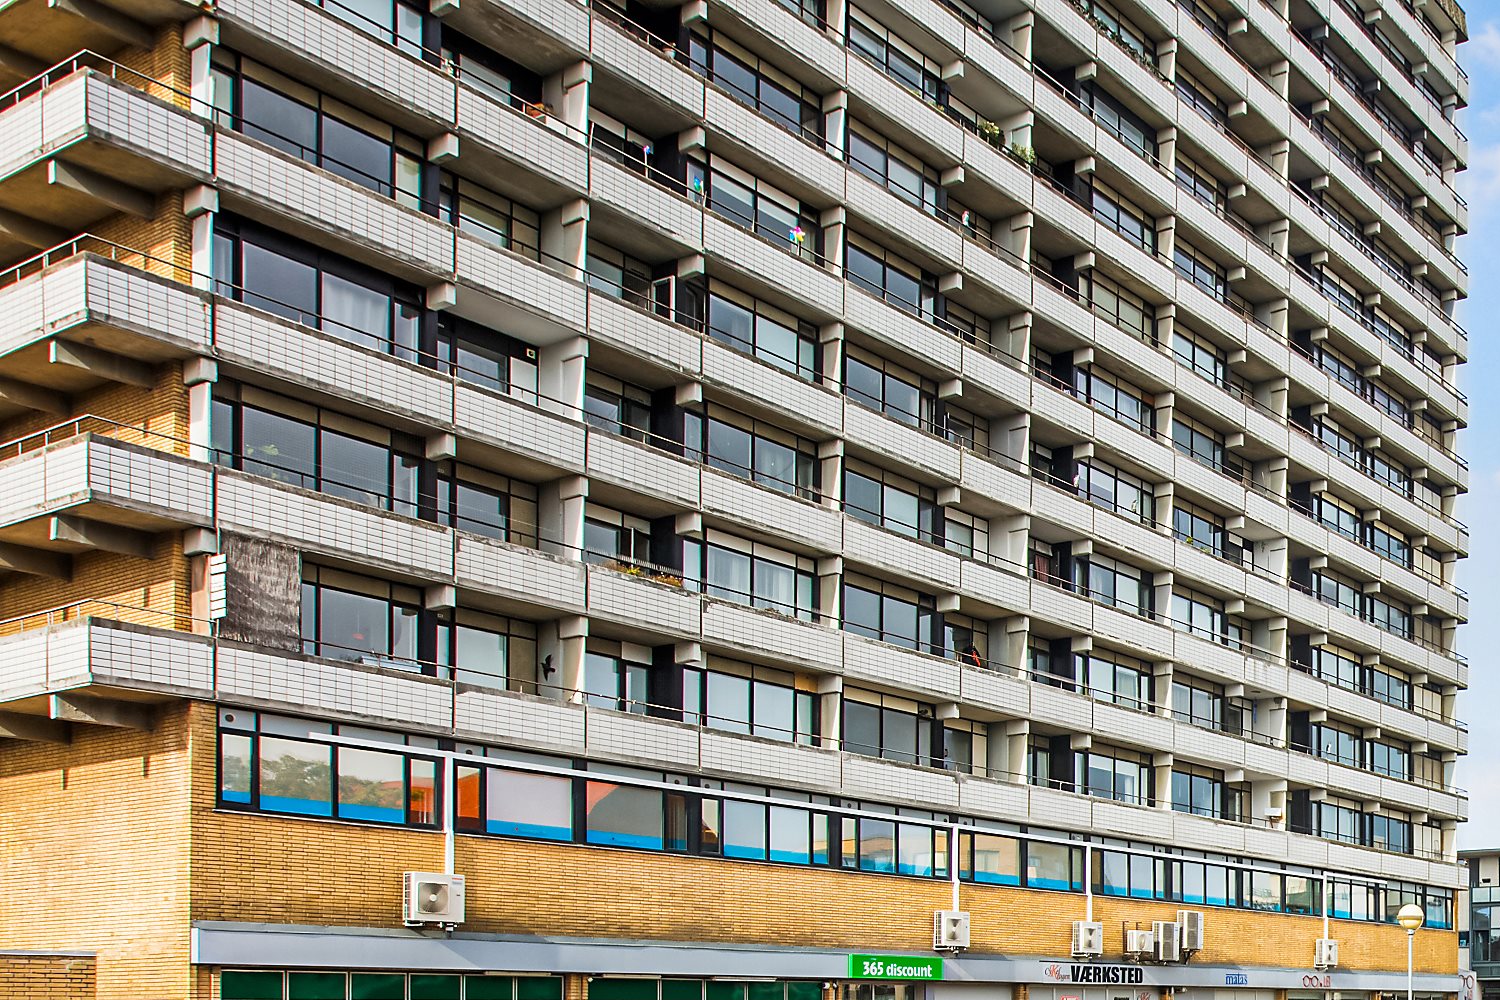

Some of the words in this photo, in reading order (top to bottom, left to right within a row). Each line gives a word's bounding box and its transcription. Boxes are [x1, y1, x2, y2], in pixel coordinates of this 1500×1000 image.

[862, 961, 884, 976] 365
[886, 963, 933, 977] discount
[1071, 965, 1143, 984] VÆRKSTED
[1225, 972, 1248, 985] matas
